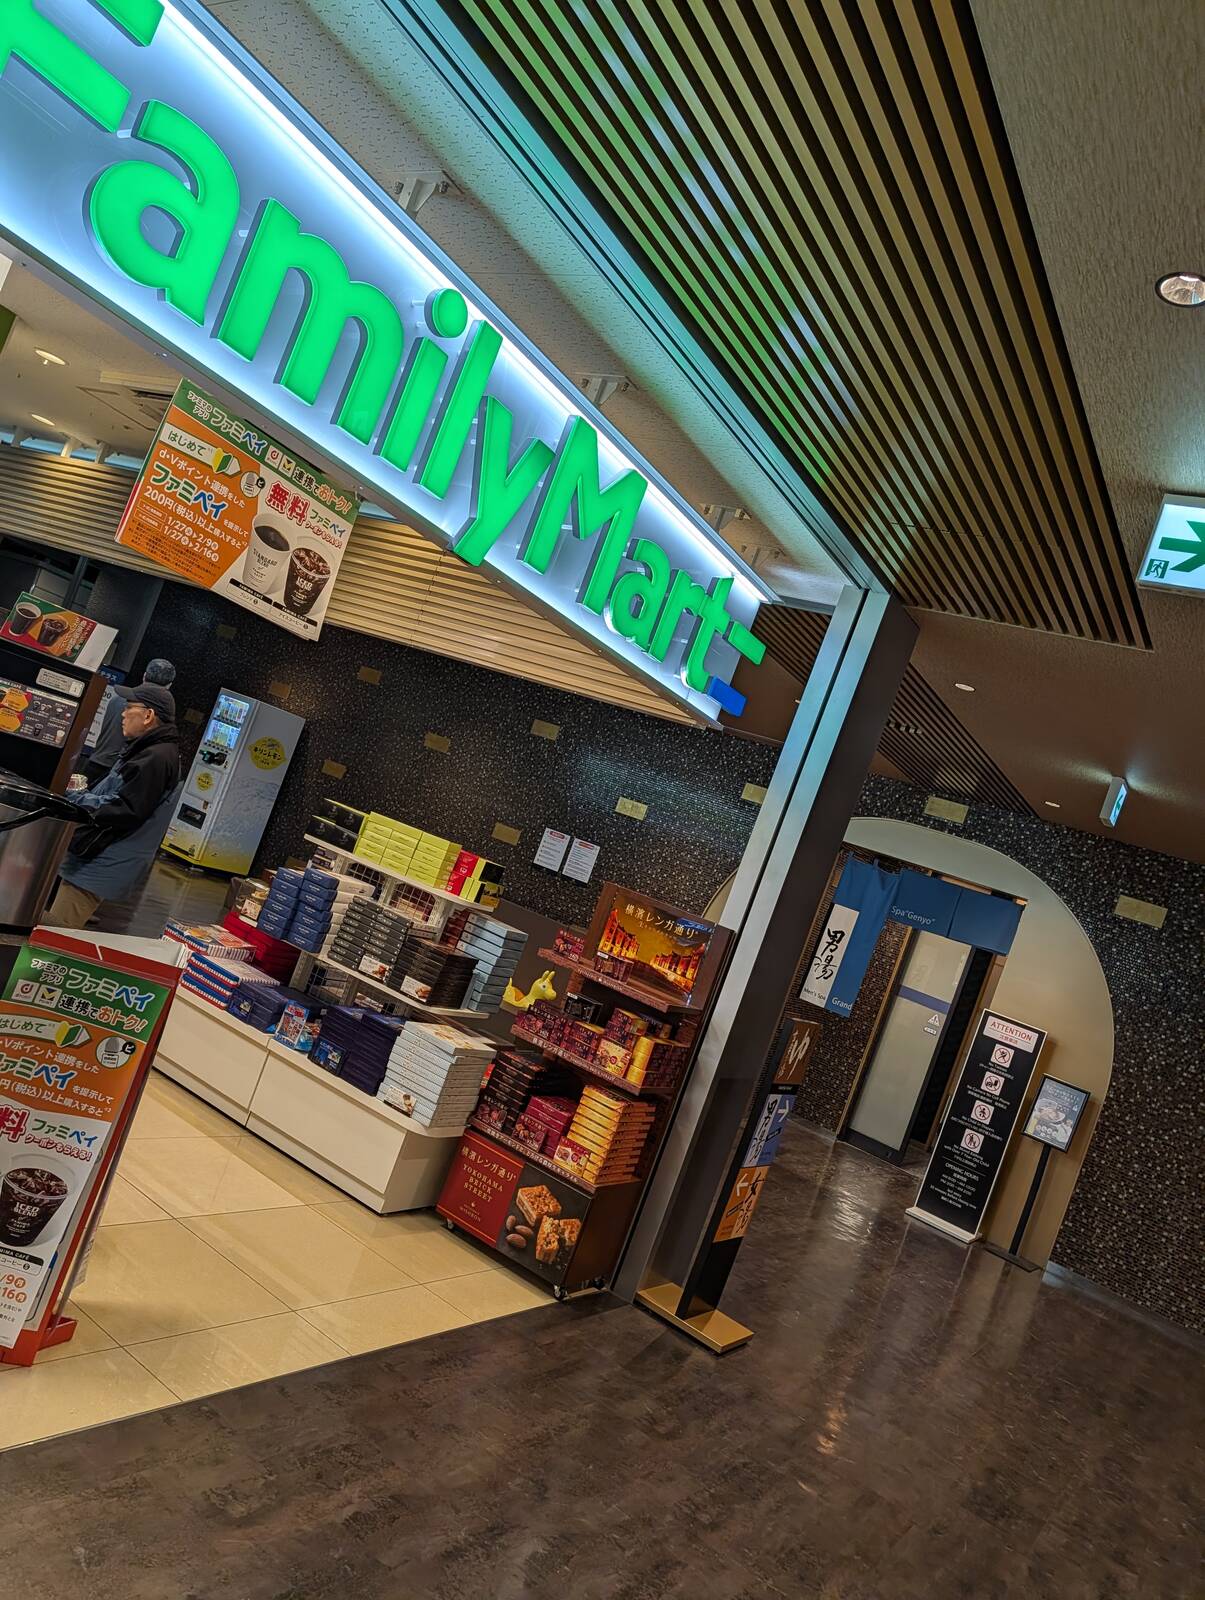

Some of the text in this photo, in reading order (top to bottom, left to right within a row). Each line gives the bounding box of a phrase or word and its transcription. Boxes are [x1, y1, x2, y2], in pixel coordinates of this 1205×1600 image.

[211, 408, 268, 455] ファミペイ
[150, 461, 228, 520] ファミペイ
[266, 481, 310, 526] 無料
[310, 509, 346, 538] ファミペイ
[31, 959, 69, 976] ファミマの
[814, 927, 845, 980] 男湯
[40, 972, 64, 986] アプリ
[66, 967, 155, 1012] ファミペイ
[58, 992, 149, 1033] 連携でおトク!
[832, 997, 853, 1010] Grand
[991, 1021, 1033, 1041] ATTENTION
[0, 1053, 77, 1090] ァミペイ
[72, 1085, 115, 1105] を提示して
[31, 1118, 98, 1147] ファミペイ
[25, 1134, 93, 1162] クーポンもらえる!
[463, 1163, 503, 1192] YOKOHAMA
[469, 1177, 492, 1194] BRICK
[464, 1182, 493, 1202] STREET
[13, 1207, 38, 1217] BLEND
[15, 1202, 40, 1213] ICED
